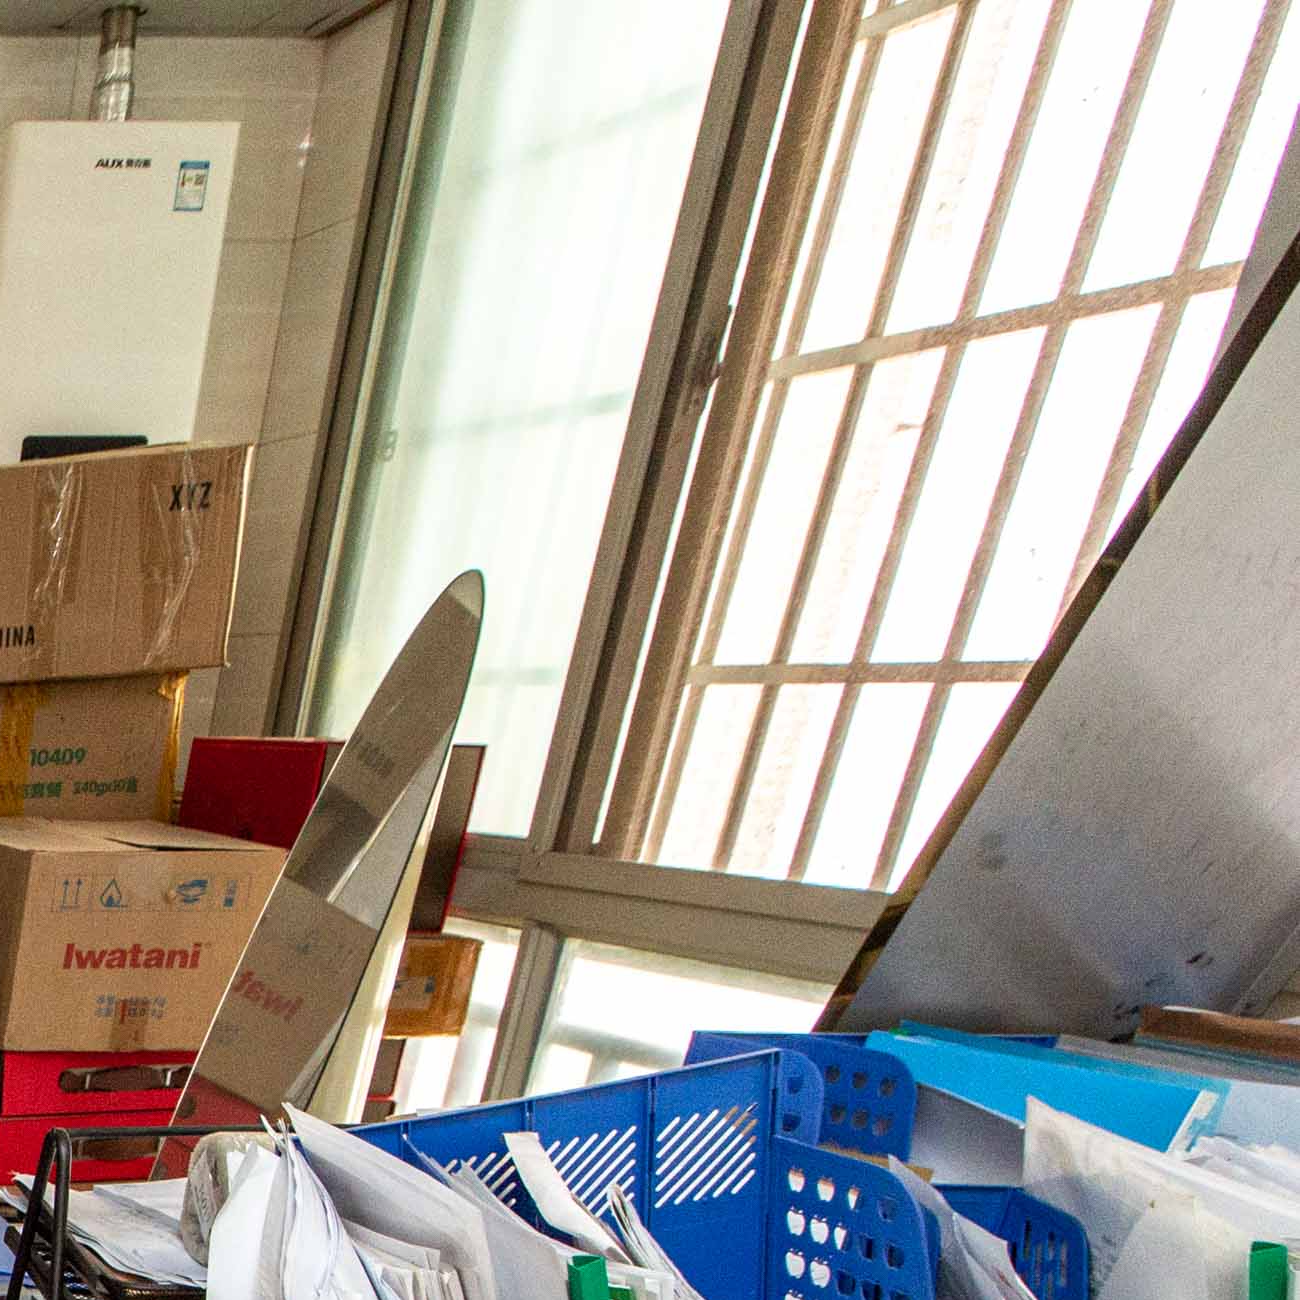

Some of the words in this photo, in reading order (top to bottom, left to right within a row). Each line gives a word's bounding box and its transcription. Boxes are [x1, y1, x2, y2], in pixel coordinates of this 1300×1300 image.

[94, 158, 124, 169] AUX
[169, 481, 213, 512] XYZ
[30, 746, 88, 768] 10409
[62, 941, 203, 970] Iwatani
